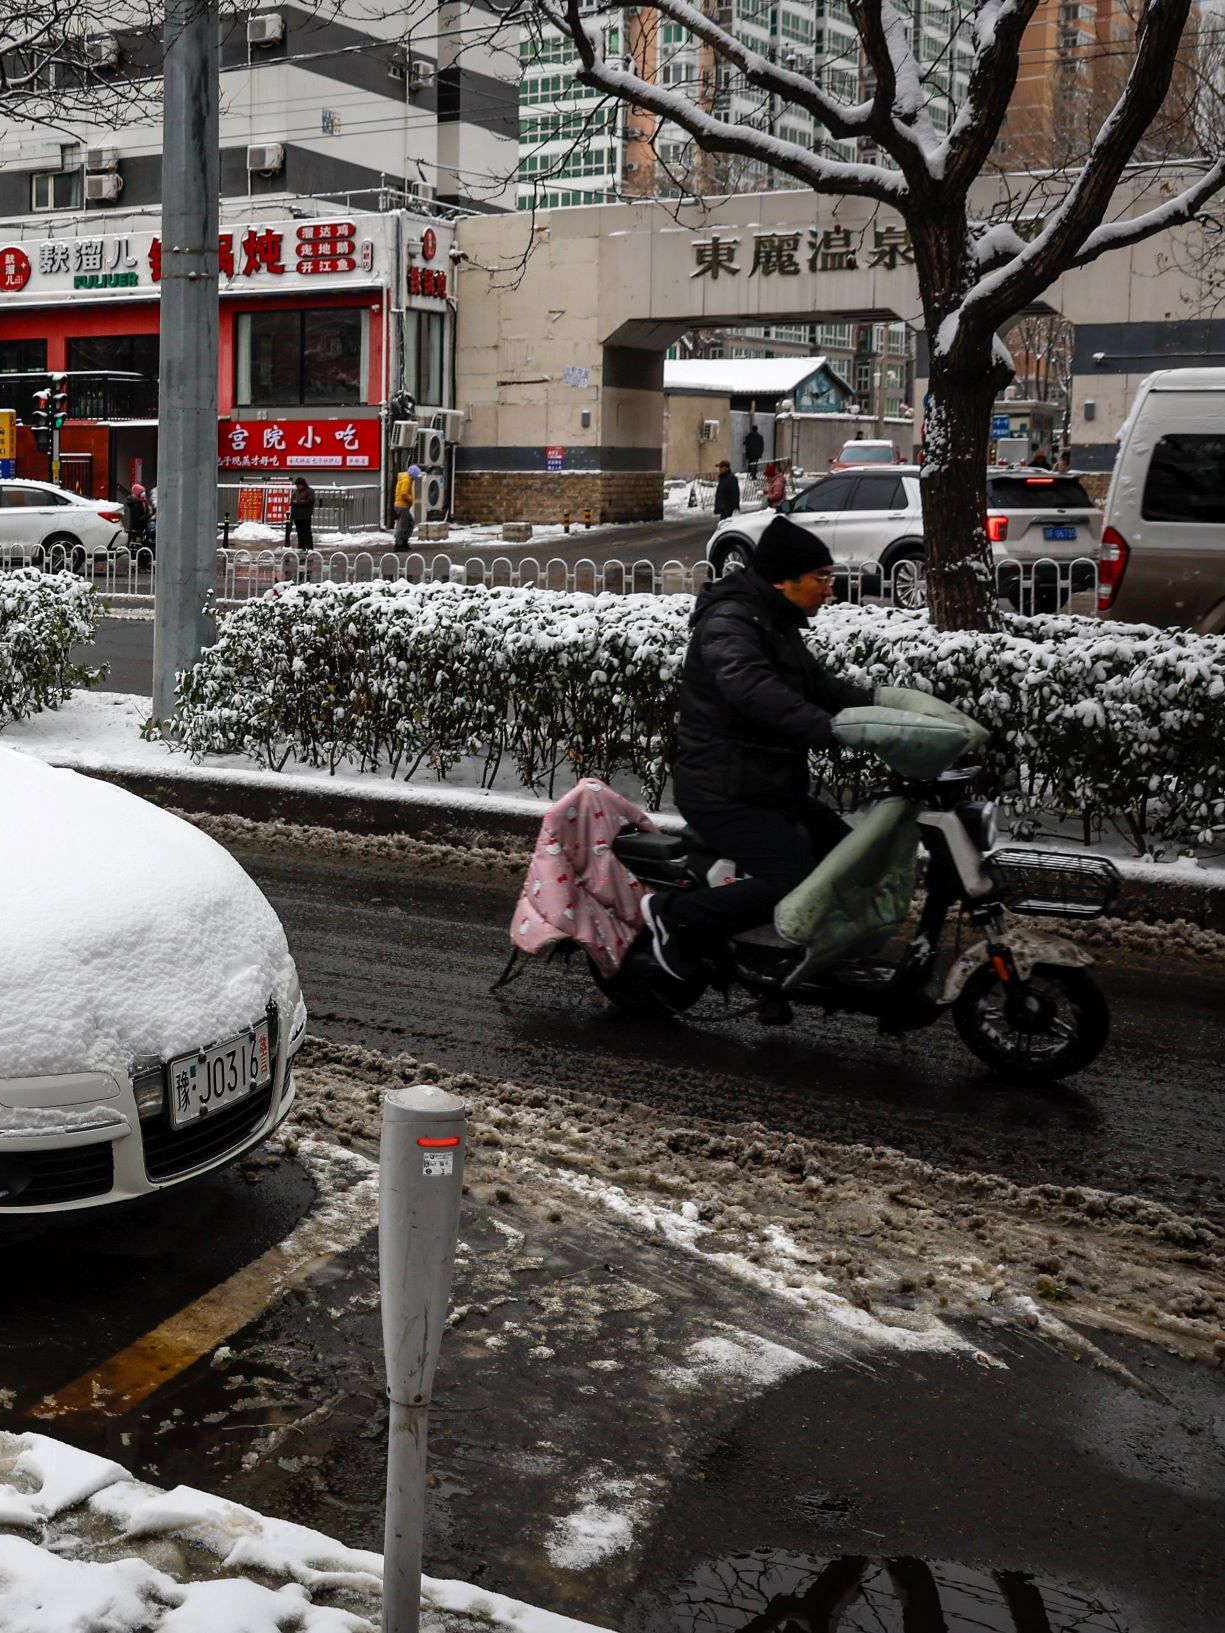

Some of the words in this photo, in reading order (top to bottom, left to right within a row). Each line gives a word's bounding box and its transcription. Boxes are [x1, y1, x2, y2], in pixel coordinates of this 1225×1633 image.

[301, 258, 350, 273] 开江鱼
[228, 424, 359, 450] 宫院小吃
